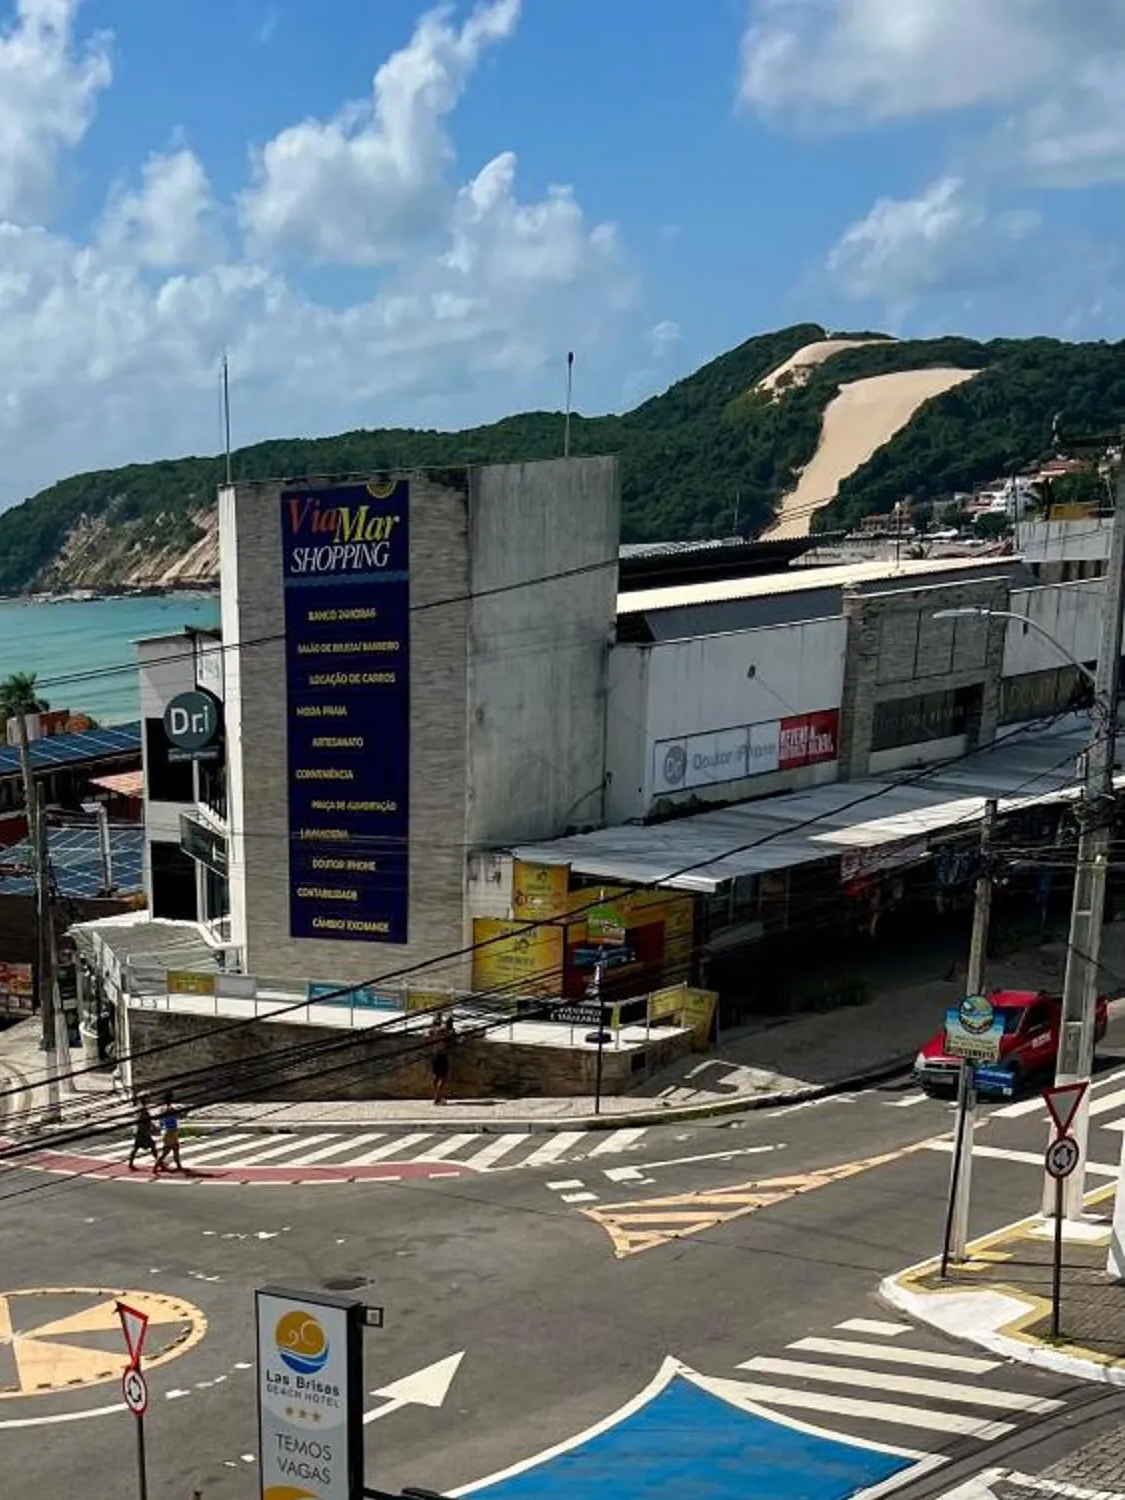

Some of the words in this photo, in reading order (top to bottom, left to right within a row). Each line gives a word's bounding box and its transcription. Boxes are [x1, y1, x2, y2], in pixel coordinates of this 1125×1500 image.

[290, 541, 391, 574] SHOPPING
[308, 671, 348, 687] LOCAÇÃO
[348, 672, 362, 684] DE
[296, 705, 322, 717] MODA
[266, 1369, 290, 1385] Las
[296, 1375, 340, 1397] Brisas
[266, 1383, 302, 1400] BEACH
[304, 1393, 340, 1409] HOTEL
[275, 1432, 332, 1461] TEMOS
[277, 1456, 332, 1485] VAGAS
